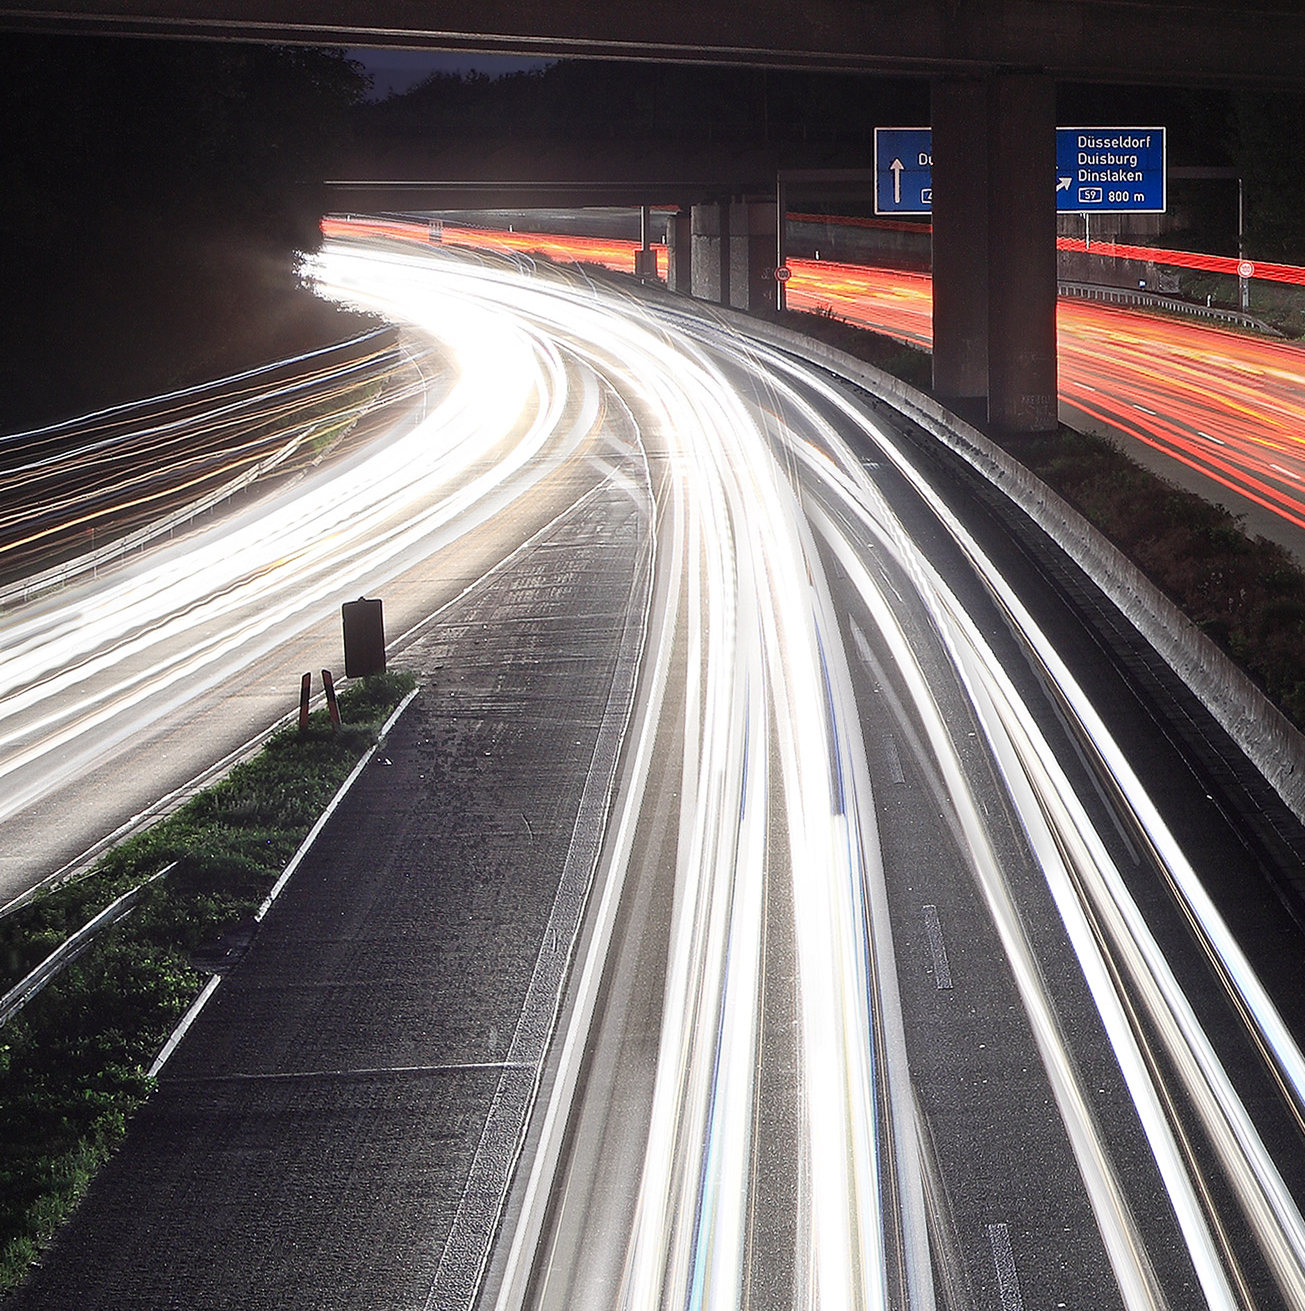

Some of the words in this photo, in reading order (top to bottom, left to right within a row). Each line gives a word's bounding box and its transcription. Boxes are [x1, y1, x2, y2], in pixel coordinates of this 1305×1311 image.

[1078, 136, 1151, 148] Düsseldorf
[1078, 152, 1137, 167] Duisburg
[1078, 169, 1143, 181] Dinslaken
[1084, 190, 1097, 199] 59
[1108, 191, 1129, 202] 800
[1133, 193, 1145, 202] m
